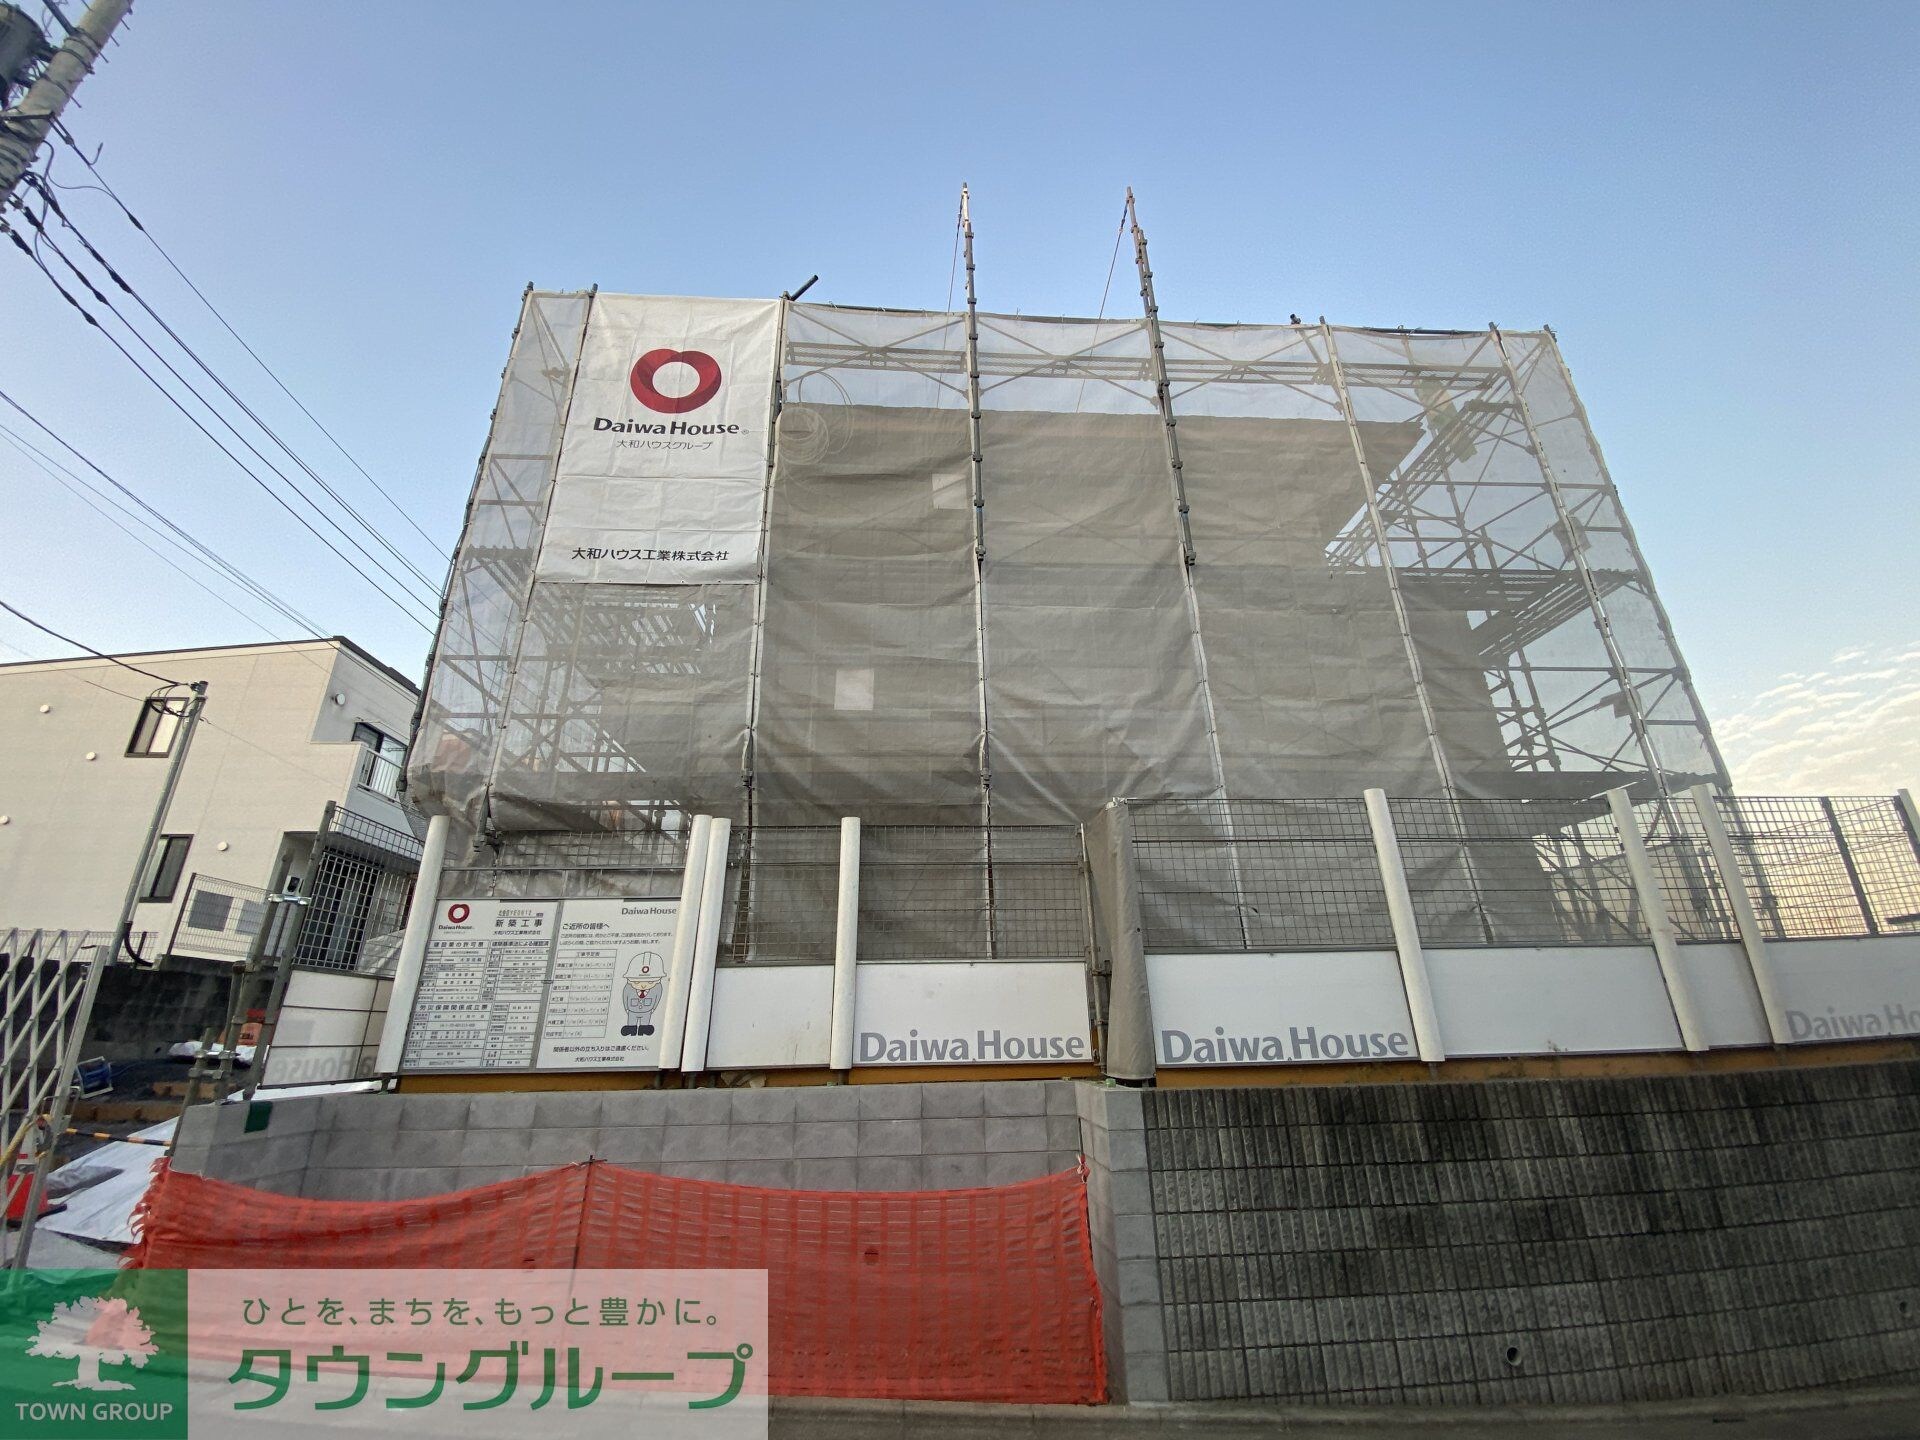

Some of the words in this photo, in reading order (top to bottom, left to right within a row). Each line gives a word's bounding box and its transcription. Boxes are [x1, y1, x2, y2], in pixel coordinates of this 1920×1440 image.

[593, 417, 666, 434] Daiwa
[670, 421, 739, 435] House
[616, 439, 713, 450] 大和ハウスグループ
[571, 547, 729, 562] 大和ハウス工業株式会社
[621, 907, 649, 915] Daiwa
[1785, 1006, 1882, 1039] Daiwa
[859, 1029, 969, 1062] Daiwa
[977, 1030, 1084, 1060] House
[1161, 1026, 1283, 1063] Daiwa
[1290, 1026, 1409, 1060] House
